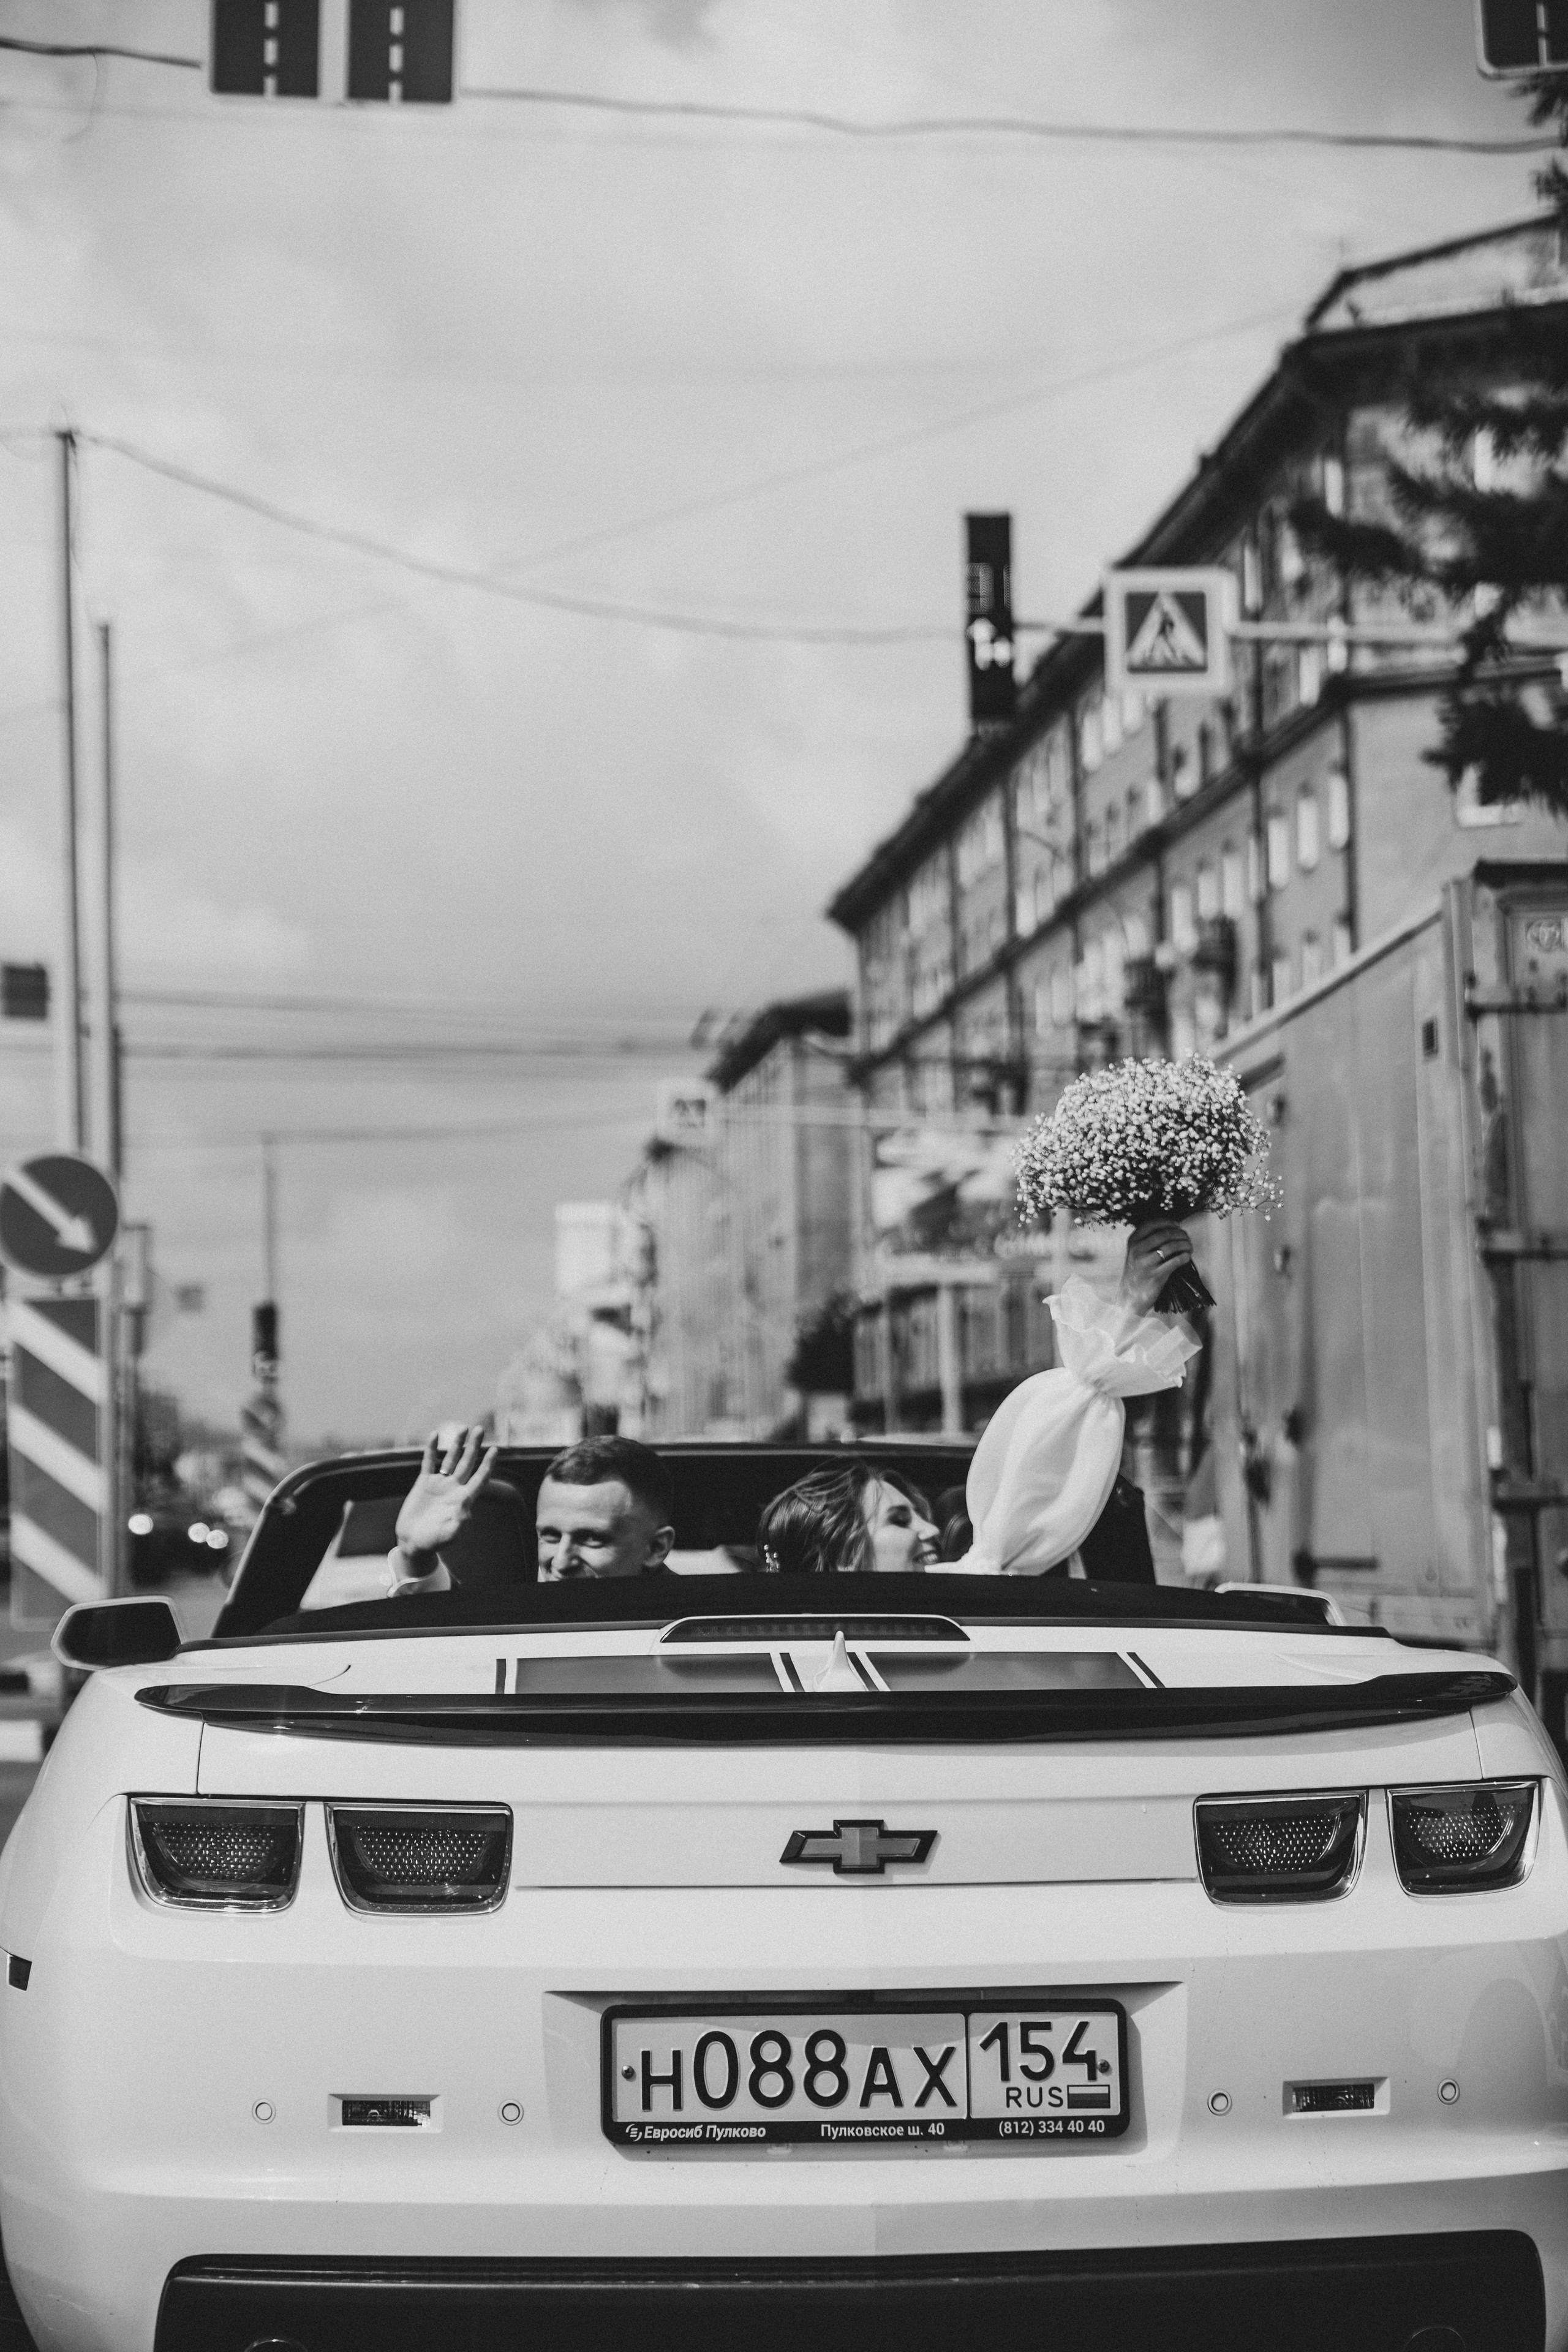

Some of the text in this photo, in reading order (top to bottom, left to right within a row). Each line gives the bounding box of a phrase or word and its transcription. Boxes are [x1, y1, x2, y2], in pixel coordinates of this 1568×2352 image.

[979, 2021, 1096, 2082] 154
[1006, 2086, 1063, 2108] RUS
[644, 2124, 766, 2142] Евросиб Пулково
[821, 2122, 944, 2140] Пулковское ш. 40
[999, 2120, 1105, 2137] (812) 334 40 40
